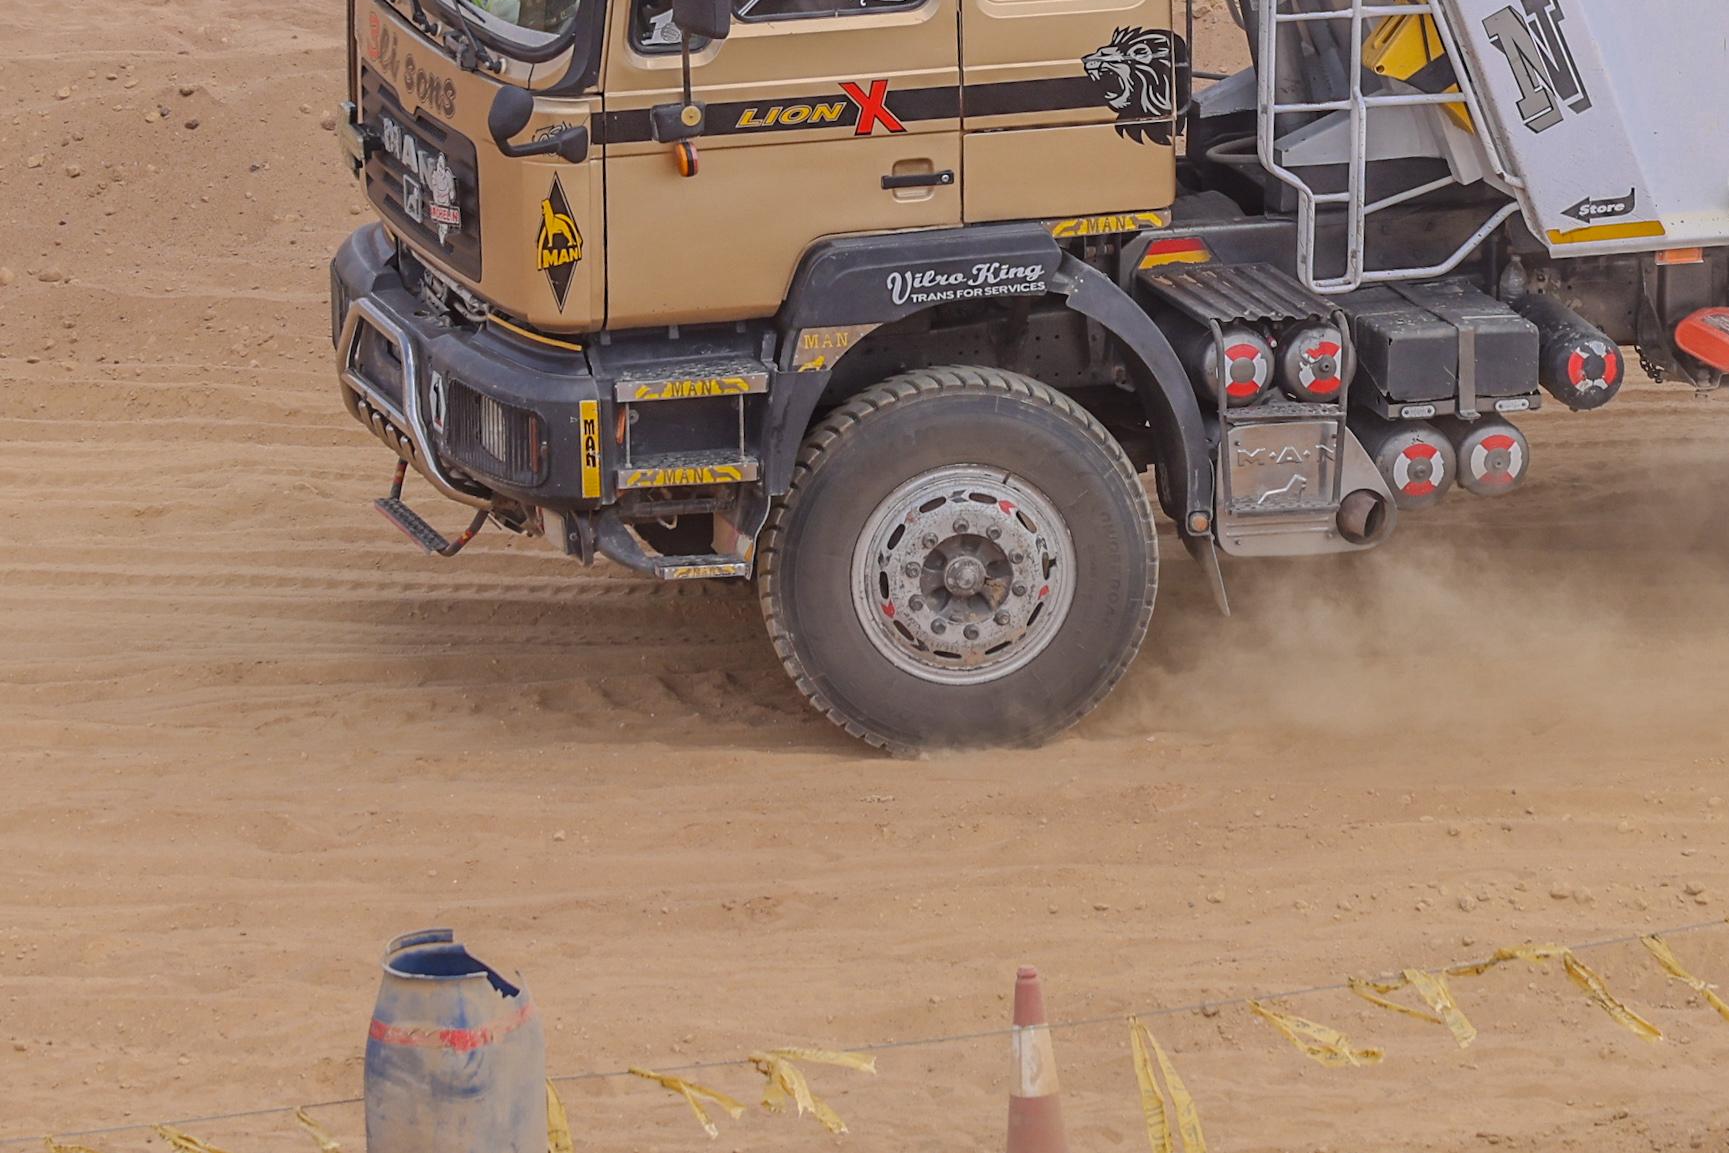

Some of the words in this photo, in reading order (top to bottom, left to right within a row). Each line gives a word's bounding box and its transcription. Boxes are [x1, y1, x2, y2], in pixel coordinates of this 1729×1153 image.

[735, 101, 847, 129] LION
[838, 79, 908, 136] X
[1578, 201, 1625, 216] Store
[1087, 215, 1126, 234] MAN
[543, 249, 579, 268] MAN
[968, 262, 1045, 286] King
[911, 290, 955, 303] TRANS
[956, 287, 983, 299] FOR
[985, 282, 1046, 296] SERVICES
[803, 332, 849, 349] MAN
[671, 381, 713, 397] MAN
[583, 419, 597, 468] MAN
[663, 468, 705, 485] MAN
